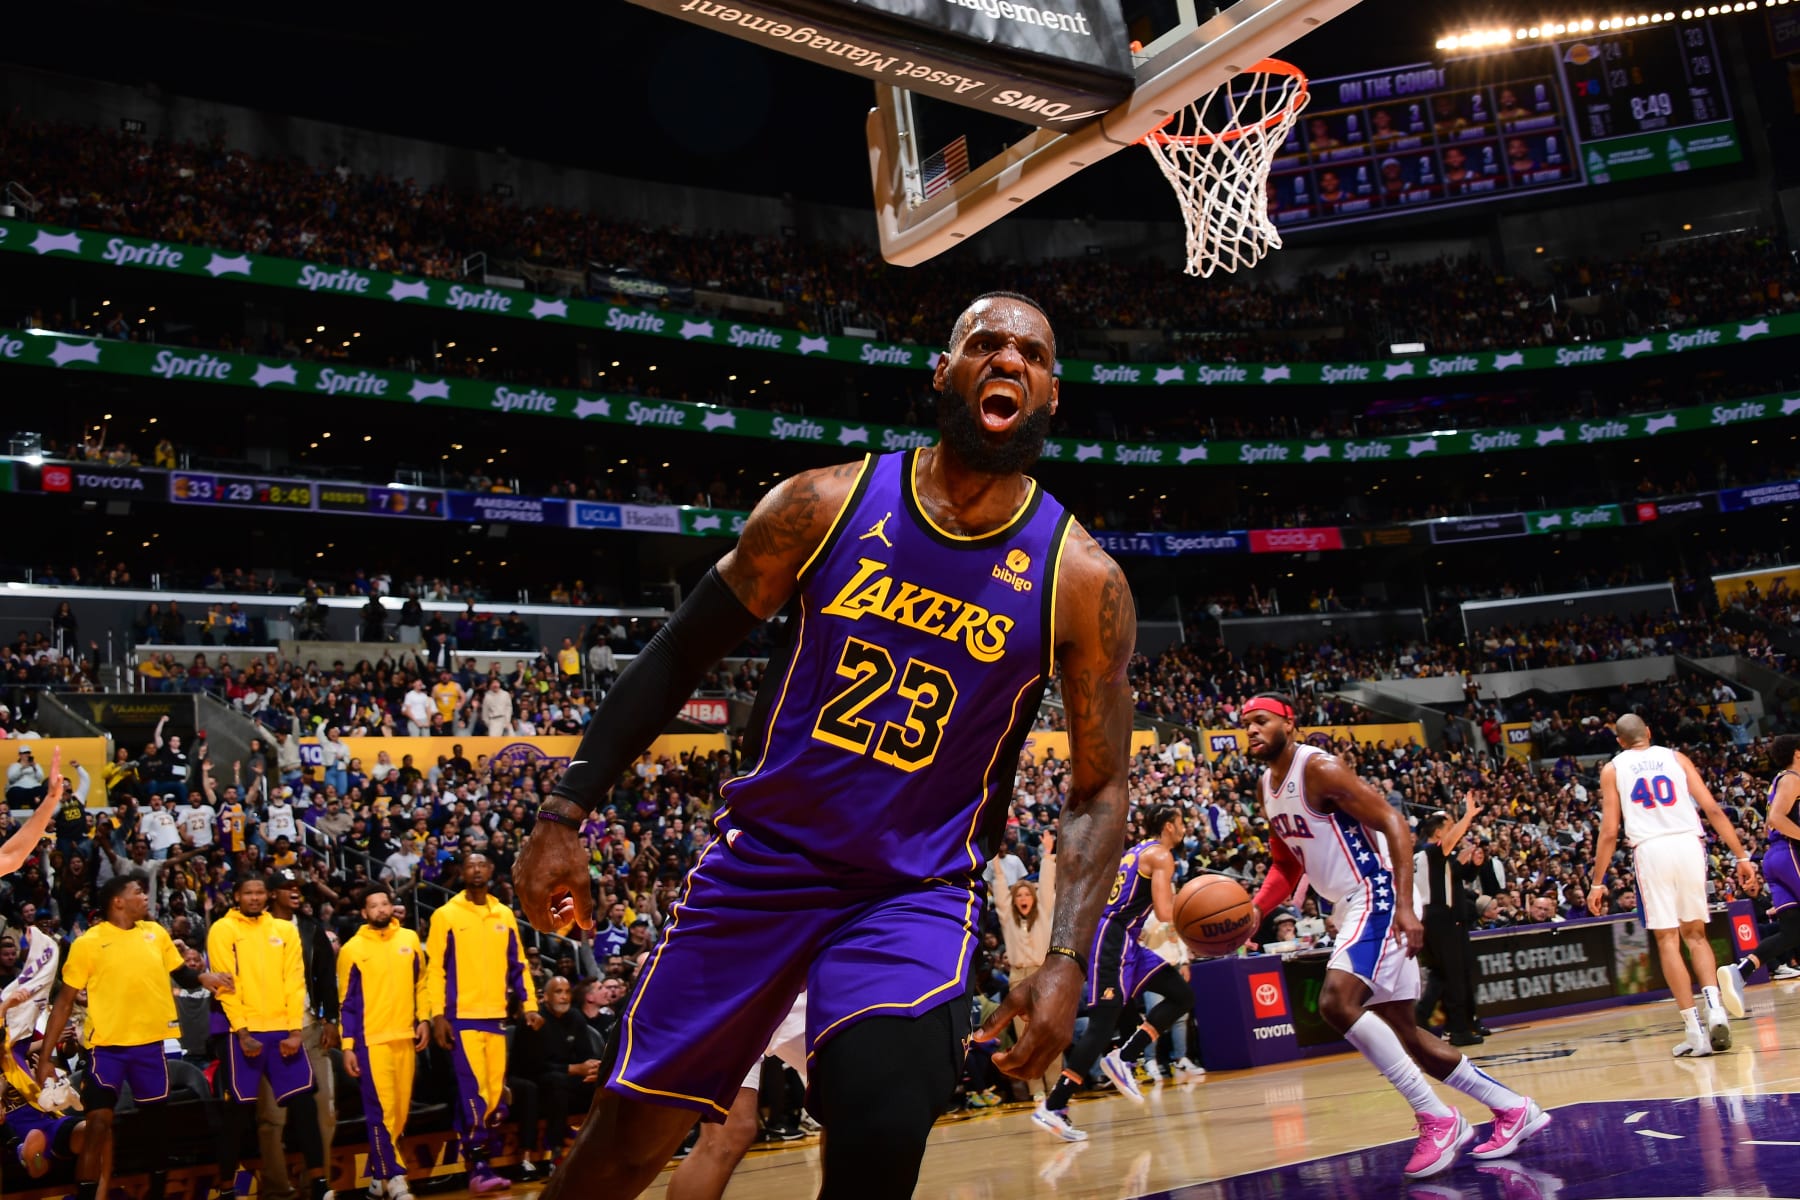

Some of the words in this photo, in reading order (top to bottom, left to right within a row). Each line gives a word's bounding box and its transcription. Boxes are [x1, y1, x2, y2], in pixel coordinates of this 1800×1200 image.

[946, 0, 1090, 36] agement
[680, 0, 899, 73] Management
[895, 61, 985, 94] Asset
[1339, 81, 1363, 104] ON
[1364, 76, 1393, 99] THE
[1395, 68, 1446, 95] COURT
[992, 89, 1071, 117] DWS
[1630, 91, 1674, 120] 8:49
[102, 238, 184, 268] Sprite
[298, 264, 370, 293] Sprite
[446, 284, 512, 312] Sprite
[605, 308, 665, 333] Sprite
[728, 325, 782, 349] Sprite
[1667, 329, 1721, 351] Sprite
[152, 350, 232, 379] Sprite
[860, 343, 912, 365] Sprite
[1555, 346, 1606, 366] Sprite
[1092, 364, 1141, 384] Sprite
[1197, 364, 1247, 384] Sprite
[1321, 364, 1369, 384] Sprite
[1427, 356, 1478, 377] Sprite
[316, 368, 388, 395] Sprite
[492, 387, 557, 413] Sprite
[626, 402, 685, 426] Sprite
[1711, 403, 1765, 425] Sprite
[770, 417, 824, 440] Sprite
[881, 429, 934, 450] Sprite
[1578, 422, 1629, 443] Sprite
[1344, 442, 1392, 462] Sprite
[1470, 432, 1521, 452] Sprite
[1115, 445, 1162, 465] Sprite
[1240, 444, 1289, 464] Sprite
[77, 473, 144, 491] TOYOTA
[188, 480, 211, 498] 33
[228, 483, 254, 501] 29
[269, 486, 310, 505] 8:49
[378, 494, 390, 510] 7
[415, 497, 427, 512] 4
[473, 497, 543, 511] AMERICAN
[1659, 500, 1703, 515] TOYOTA
[484, 508, 544, 523] EXPRESS
[581, 507, 618, 523] UCLA
[626, 510, 675, 529] Health
[1571, 507, 1612, 527] Sprite
[1165, 534, 1237, 553] Spectrum
[992, 565, 1032, 592] bibigo
[821, 557, 1015, 663] LAKERS
[811, 636, 959, 773] 23
[300, 745, 322, 764] 10
[1630, 760, 1664, 775] BATUM
[1630, 774, 1677, 810] 40
[1201, 913, 1251, 938] Wilson
[1477, 952, 1514, 976] THE
[1515, 943, 1589, 971] OFFICIAL
[1475, 979, 1516, 1005] AME
[1517, 974, 1553, 999] DAY
[1553, 966, 1610, 993] SNACK
[1252, 1023, 1296, 1040] TOYOTA
